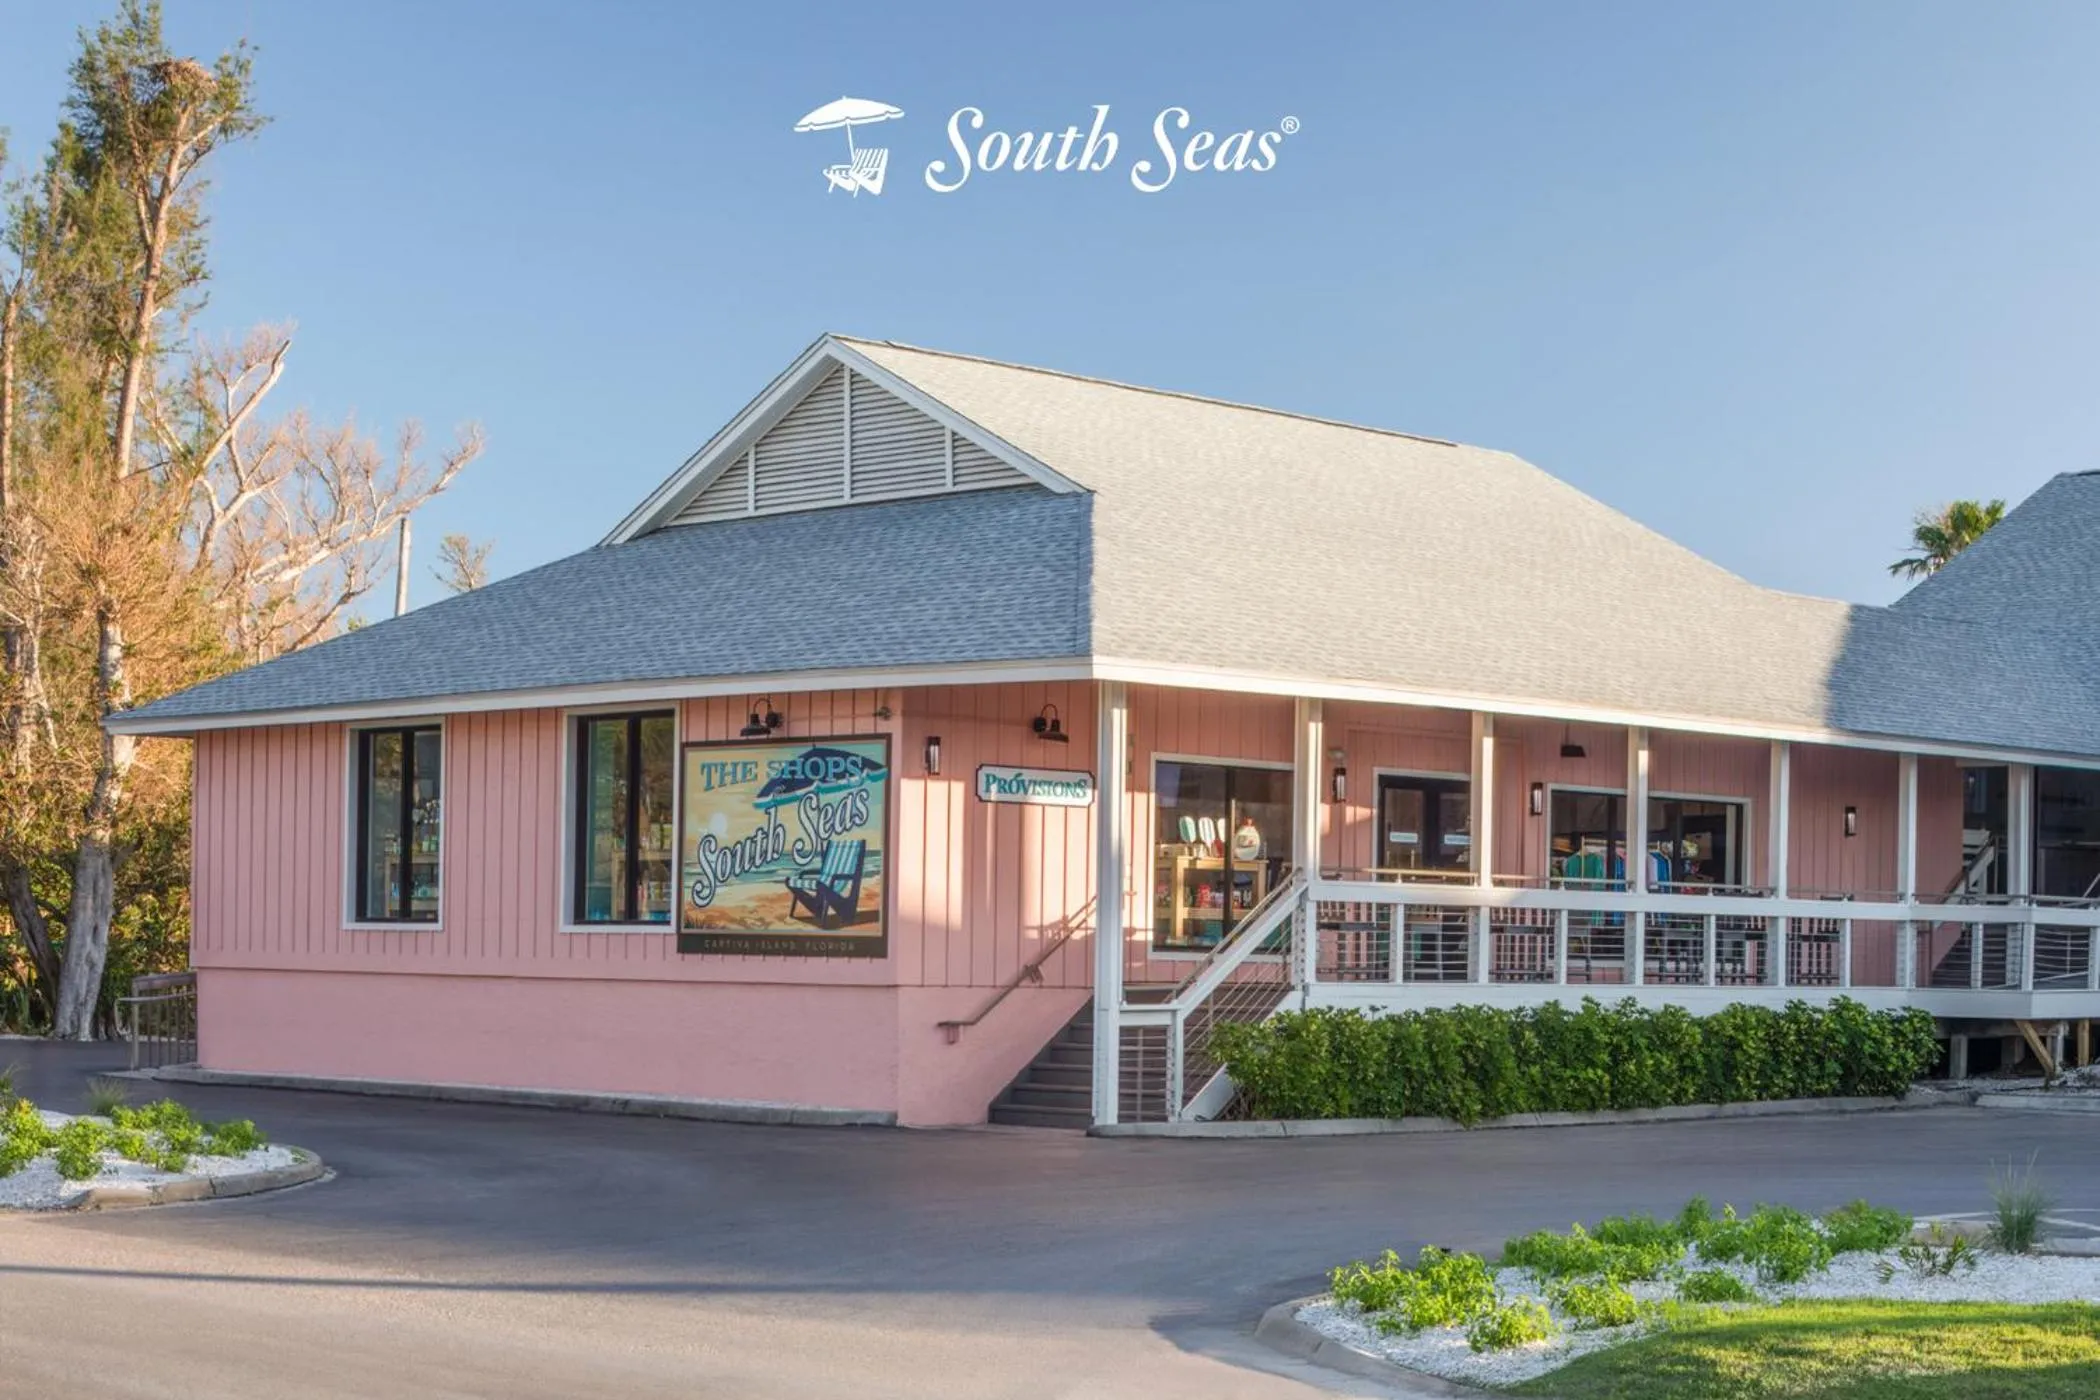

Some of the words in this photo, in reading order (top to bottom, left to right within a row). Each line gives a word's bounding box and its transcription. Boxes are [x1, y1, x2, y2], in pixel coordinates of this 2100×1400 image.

[701, 760, 758, 792] THE
[766, 755, 863, 782] SHOPS
[691, 805, 786, 908] South
[792, 788, 870, 867] Seas
